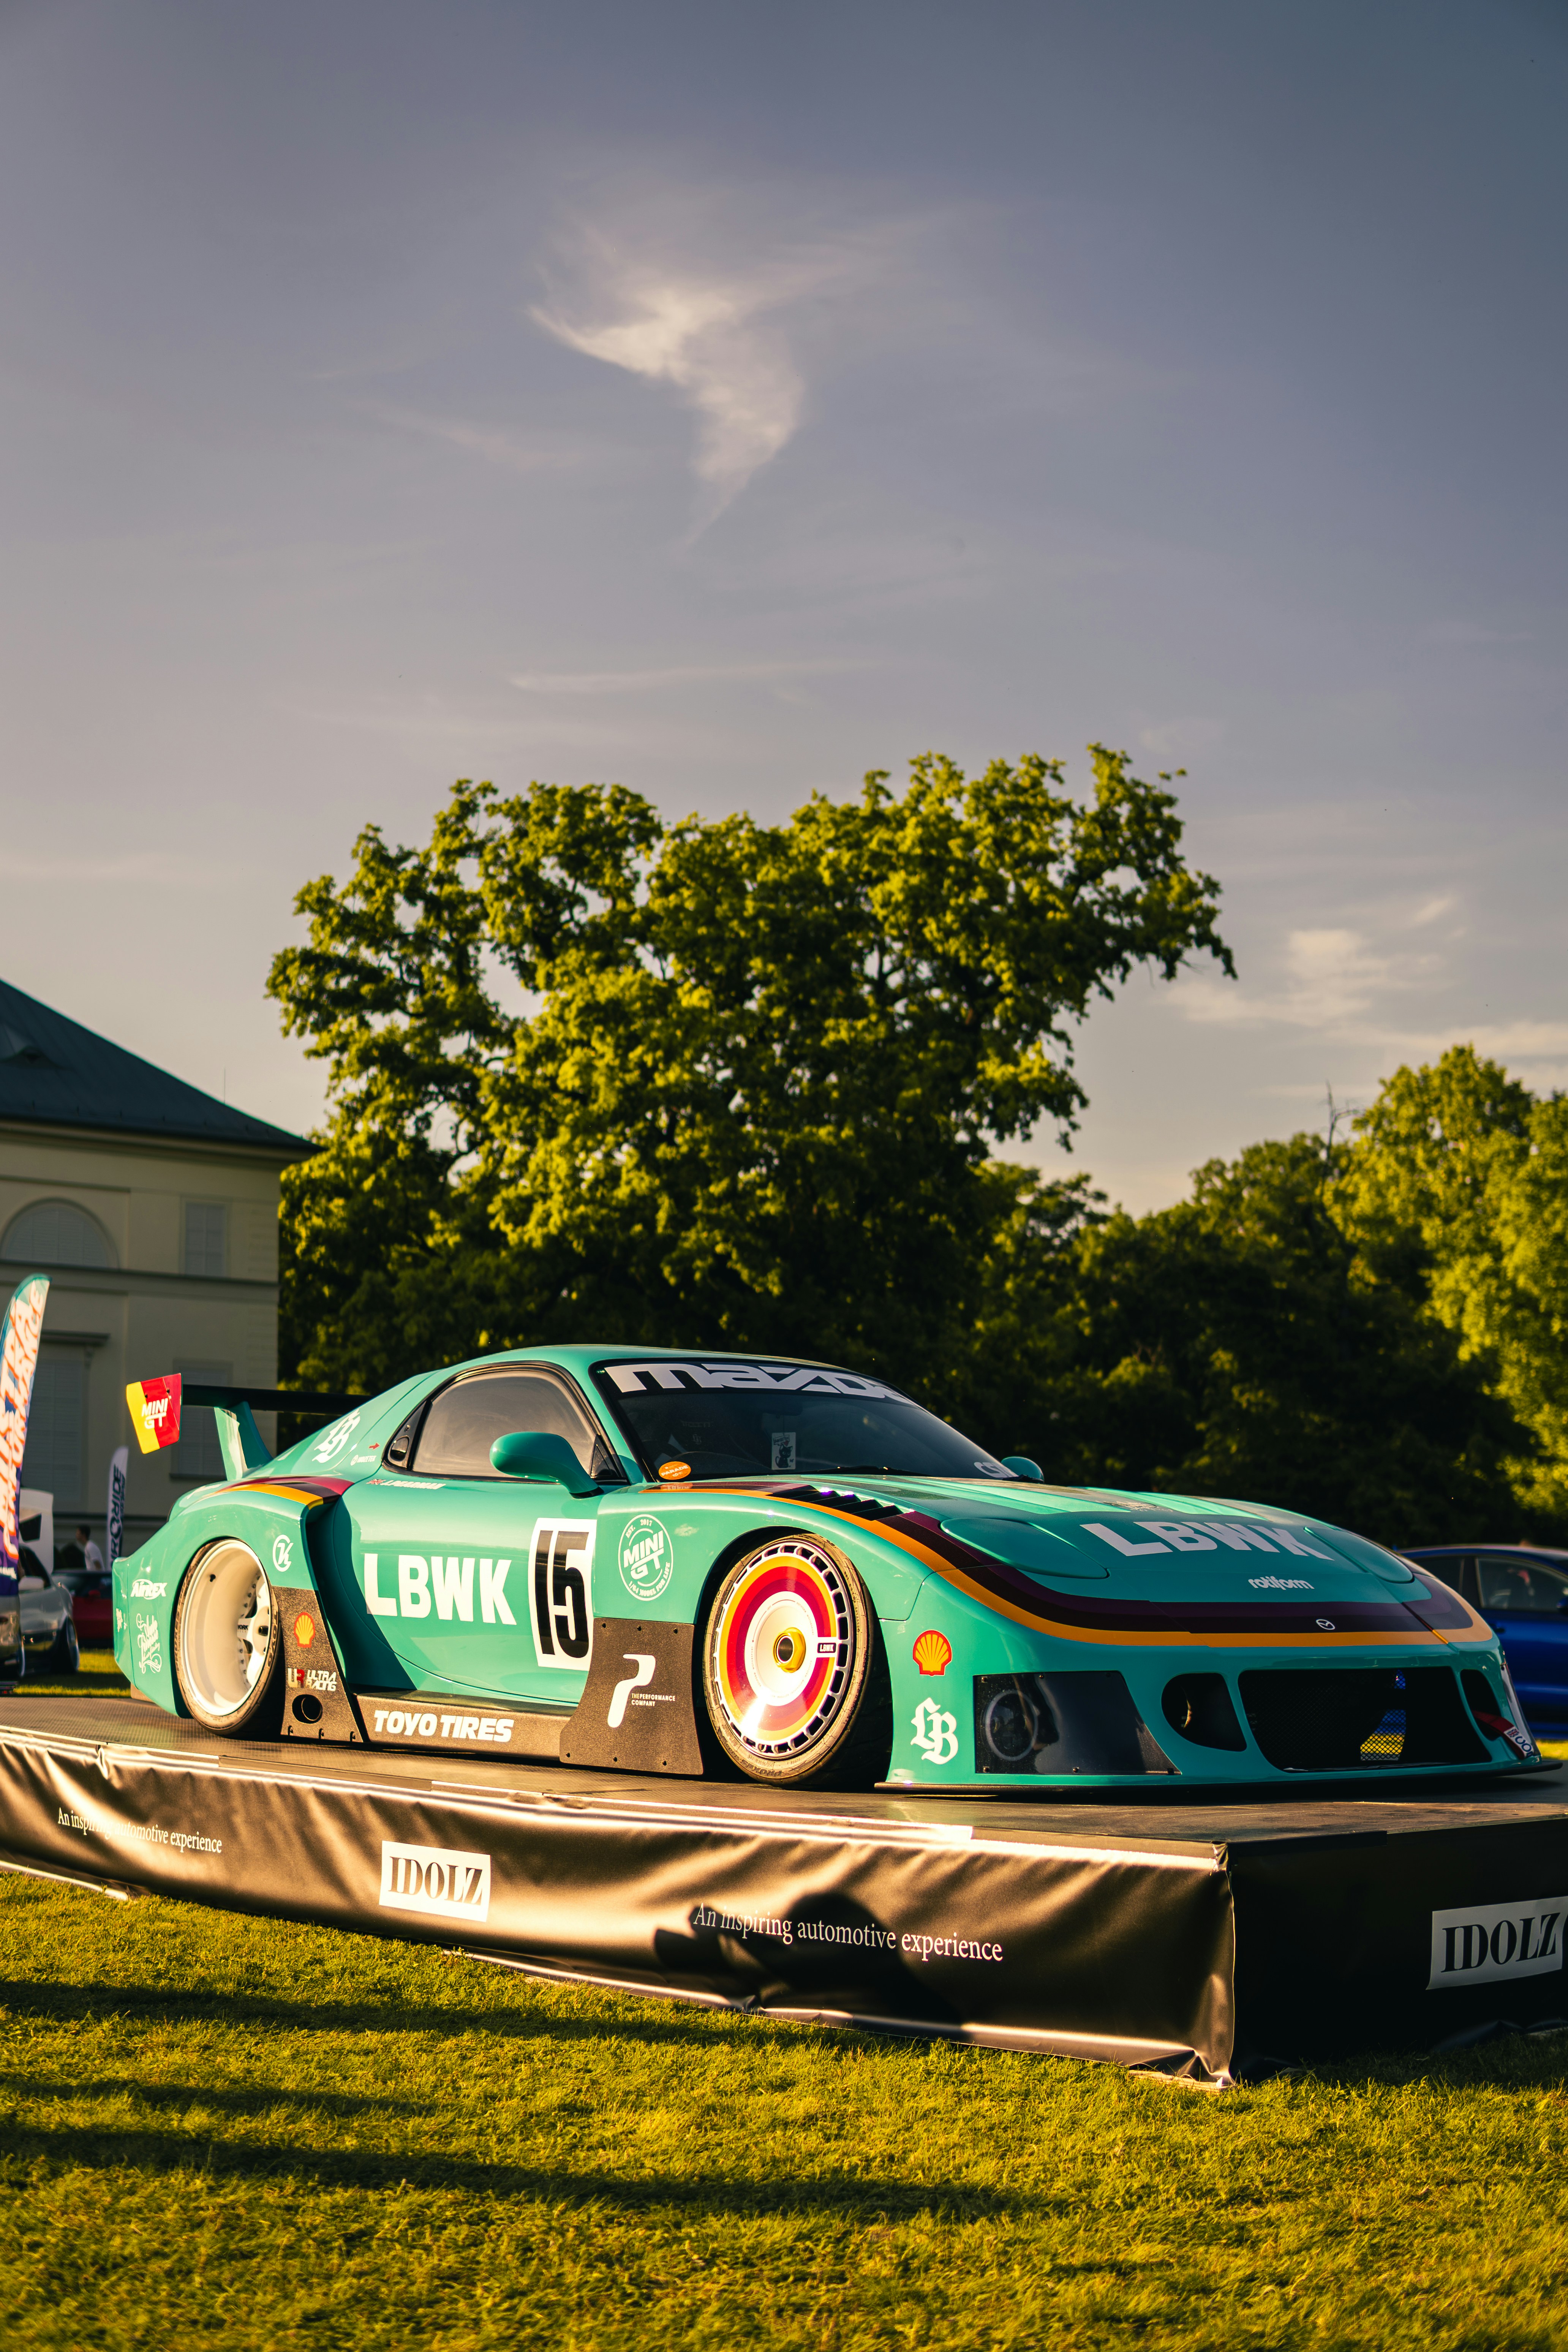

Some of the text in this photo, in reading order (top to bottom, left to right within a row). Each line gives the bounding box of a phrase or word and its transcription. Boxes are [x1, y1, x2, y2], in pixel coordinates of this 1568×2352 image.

[142, 1398, 168, 1417] MINI
[144, 1412, 167, 1429] GT
[661, 1465, 689, 1476] PARADE
[623, 1530, 664, 1568] MINI
[1080, 1521, 1335, 1561] LBWK
[631, 1548, 664, 1579] GT
[364, 1553, 517, 1625] LBWK
[535, 1530, 590, 1658] 15
[639, 1588, 656, 1596] MODEL
[656, 1578, 665, 1592] FOR
[1248, 1575, 1315, 1590] rotiform
[268, 1611, 278, 1667] TOYO
[305, 1679, 337, 1691] RACING
[307, 1669, 337, 1682] ULTRA
[374, 1710, 515, 1743] TOYO TIRES
[58, 1807, 222, 1853] An inspiring automotive experience
[388, 1856, 483, 1905] IDOLZ
[694, 1903, 1003, 1961] An inspiring automotive experience
[1440, 1912, 1561, 1973] IDOLZ
